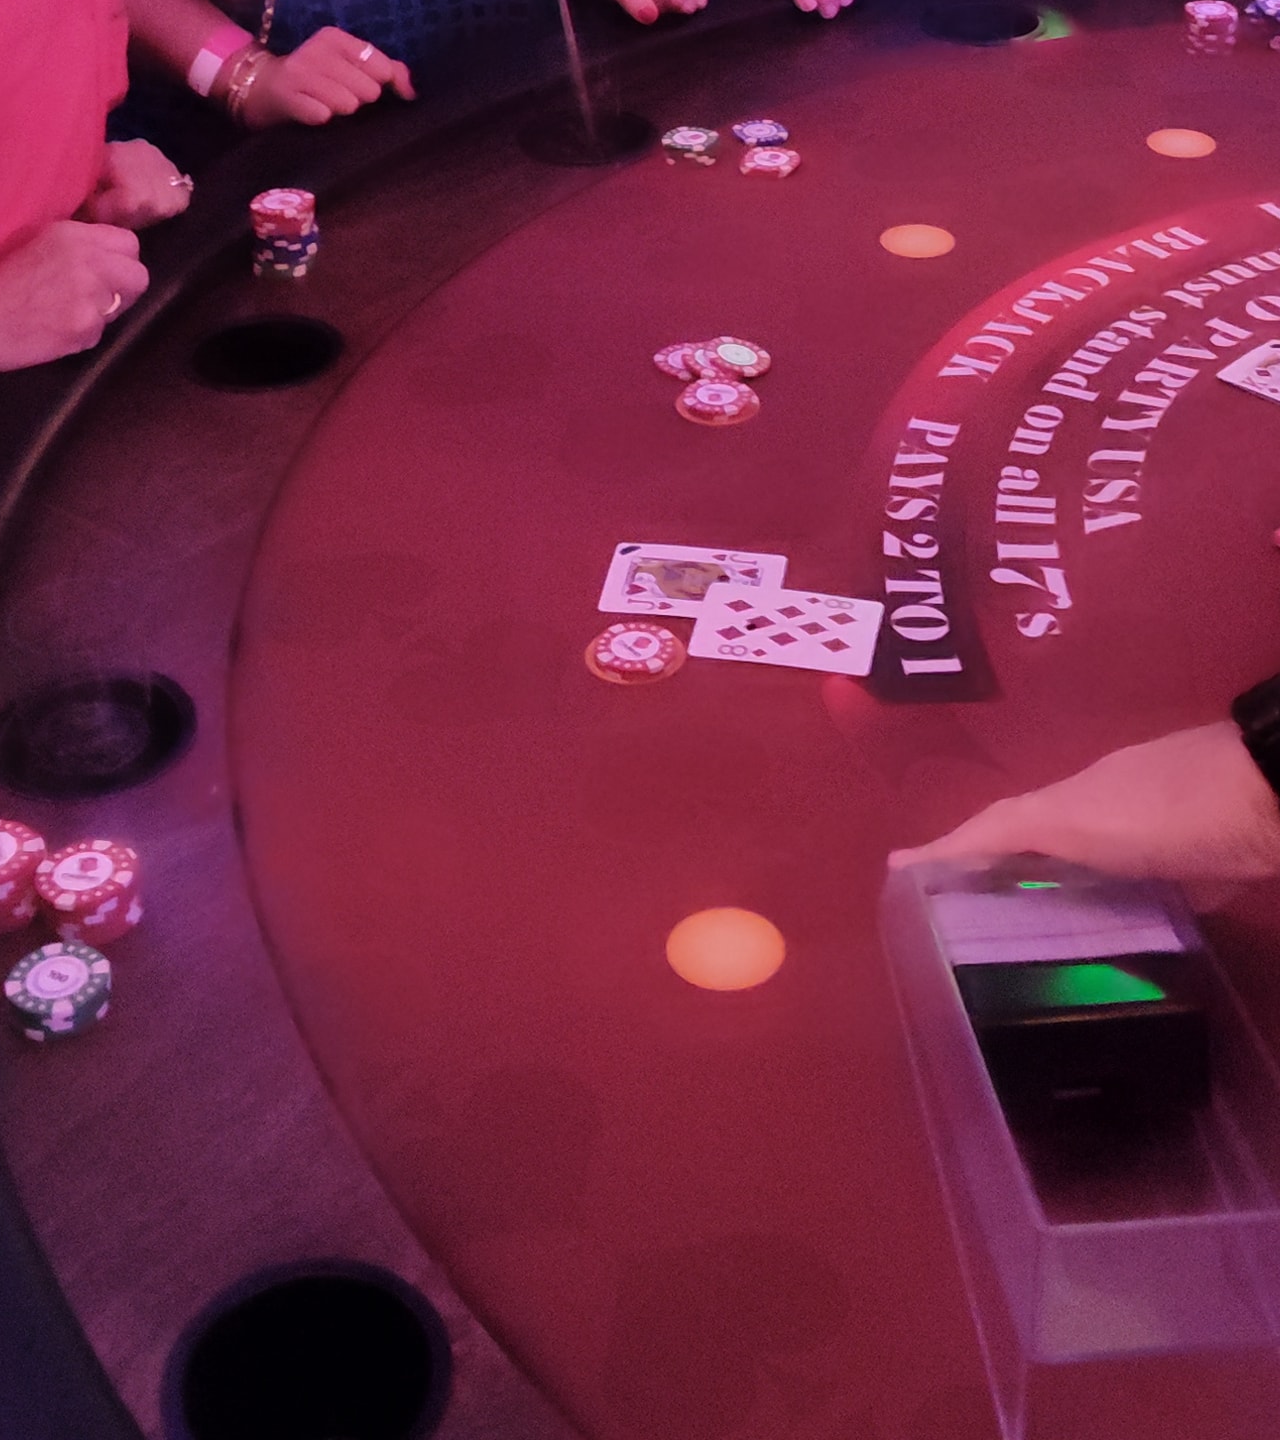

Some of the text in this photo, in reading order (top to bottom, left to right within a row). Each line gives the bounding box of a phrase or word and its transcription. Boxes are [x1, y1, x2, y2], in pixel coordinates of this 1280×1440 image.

[1041, 304, 1168, 403] stand
[1101, 317, 1254, 442] PARTY
[882, 225, 1210, 676] BLACKJACK PAYS 2 TO 1
[1007, 404, 1065, 456] on
[994, 465, 1057, 525] all
[1082, 447, 1148, 536] USA
[729, 553, 758, 566] J
[627, 597, 656, 611] J
[824, 598, 855, 611] 8
[717, 643, 748, 657] 8
